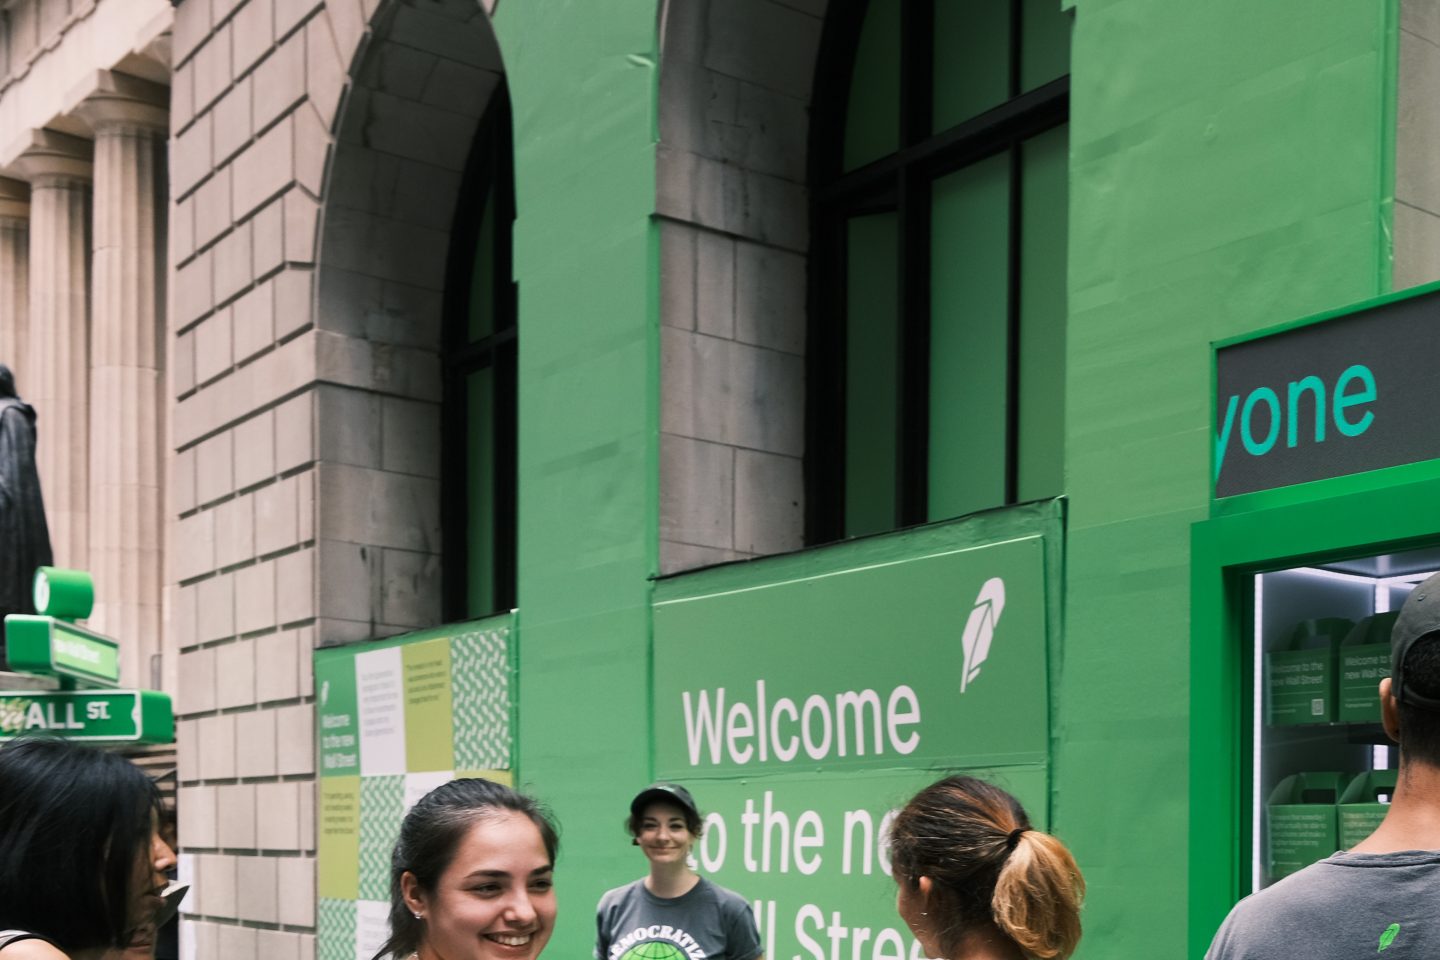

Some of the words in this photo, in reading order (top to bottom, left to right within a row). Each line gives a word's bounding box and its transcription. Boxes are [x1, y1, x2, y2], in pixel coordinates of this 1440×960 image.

[14, 702, 85, 729] ALL
[682, 679, 921, 765] Welcome
[686, 811, 727, 872] o
[742, 791, 824, 875] the
